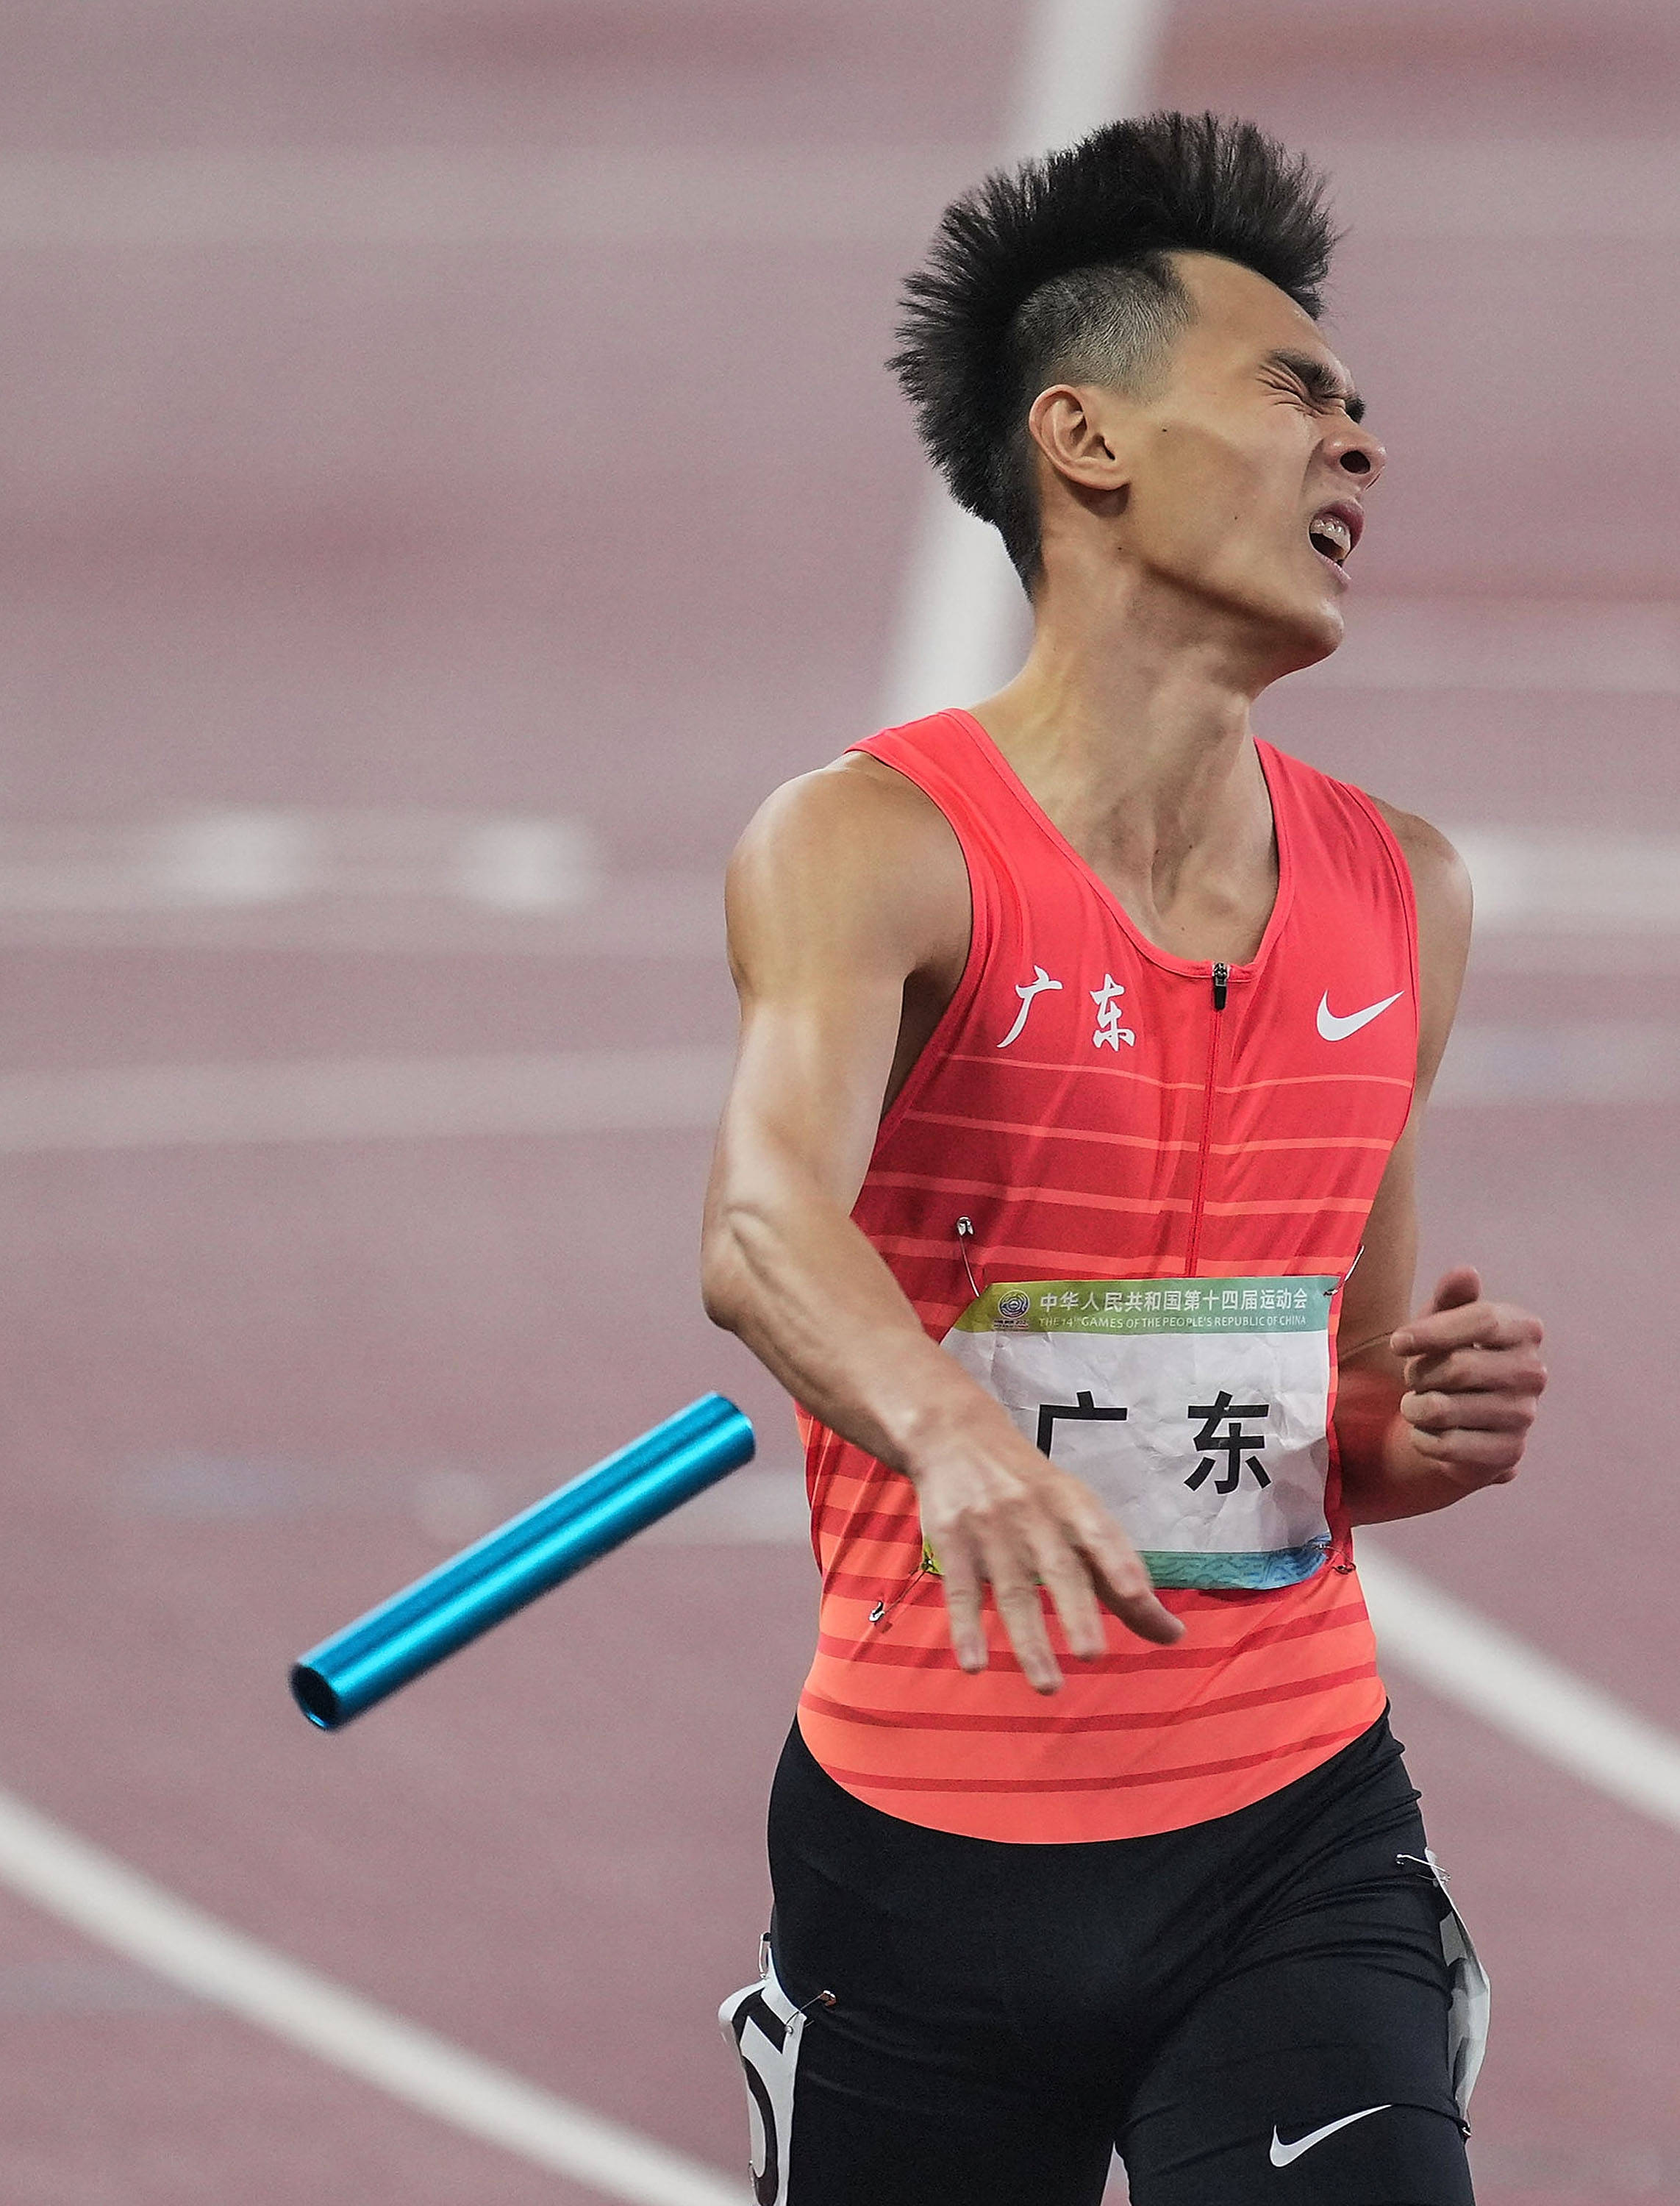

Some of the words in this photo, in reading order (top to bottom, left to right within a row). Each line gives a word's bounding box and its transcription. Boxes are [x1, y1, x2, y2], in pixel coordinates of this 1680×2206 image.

[996, 965, 1134, 1052] 广东
[1039, 1317, 1059, 1327] THE
[1082, 1316, 1123, 1328] GAMES
[1126, 1318, 1140, 1328] OF
[1142, 1317, 1162, 1327] THE
[1162, 1316, 1213, 1327] PEOPLE'S
[1214, 1316, 1265, 1327] REPUBLIC
[1266, 1316, 1278, 1326] OF
[1279, 1315, 1307, 1326] CHINA
[1040, 1288, 1308, 1313] 中华人民共和国第十四届运动会
[1036, 1390, 1272, 1495] 广东
